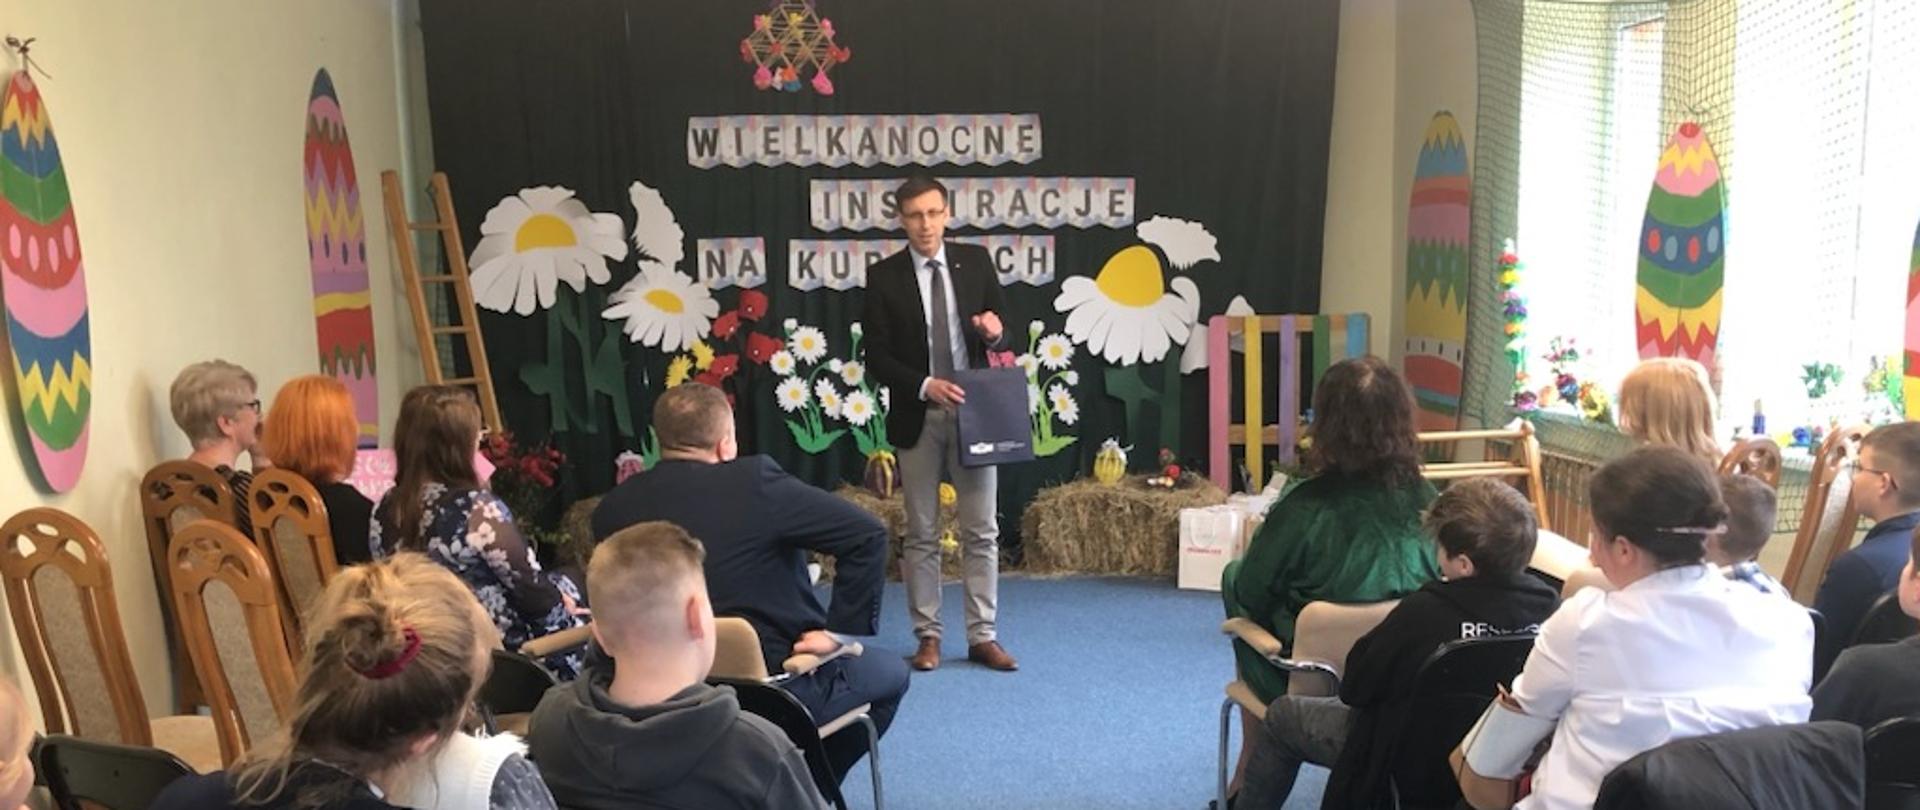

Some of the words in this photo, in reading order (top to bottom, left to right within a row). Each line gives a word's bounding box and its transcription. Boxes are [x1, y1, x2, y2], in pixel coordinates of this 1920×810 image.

[692, 124, 1034, 157] WIELKANOCNE
[823, 189, 1126, 220] INSIRACJE
[706, 248, 759, 279] NA
[799, 246, 1047, 280] KUCH
